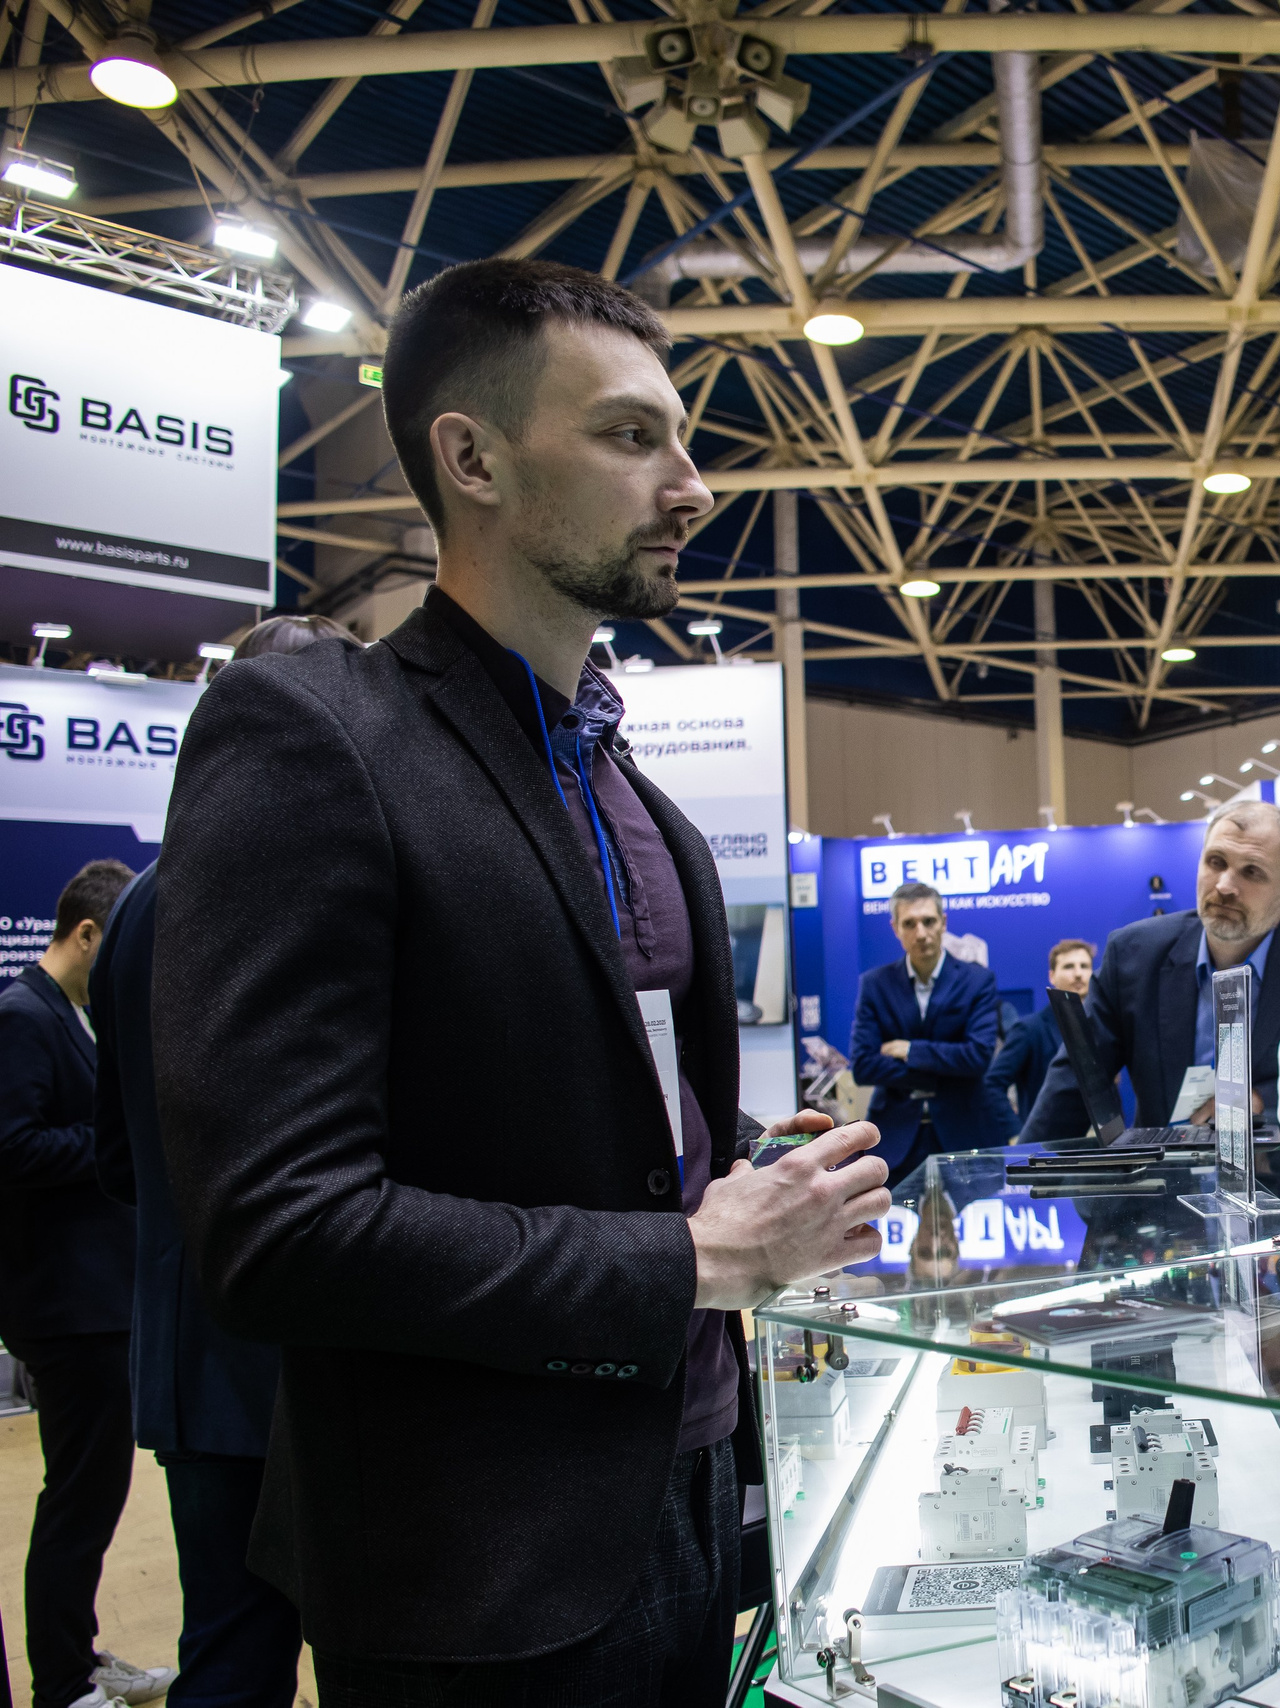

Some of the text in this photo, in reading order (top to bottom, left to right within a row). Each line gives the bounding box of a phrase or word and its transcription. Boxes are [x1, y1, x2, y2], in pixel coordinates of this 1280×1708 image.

[80, 397, 234, 456] BASIS
[55, 536, 190, 569] www.basisparts.ru
[617, 716, 745, 733] жная основа
